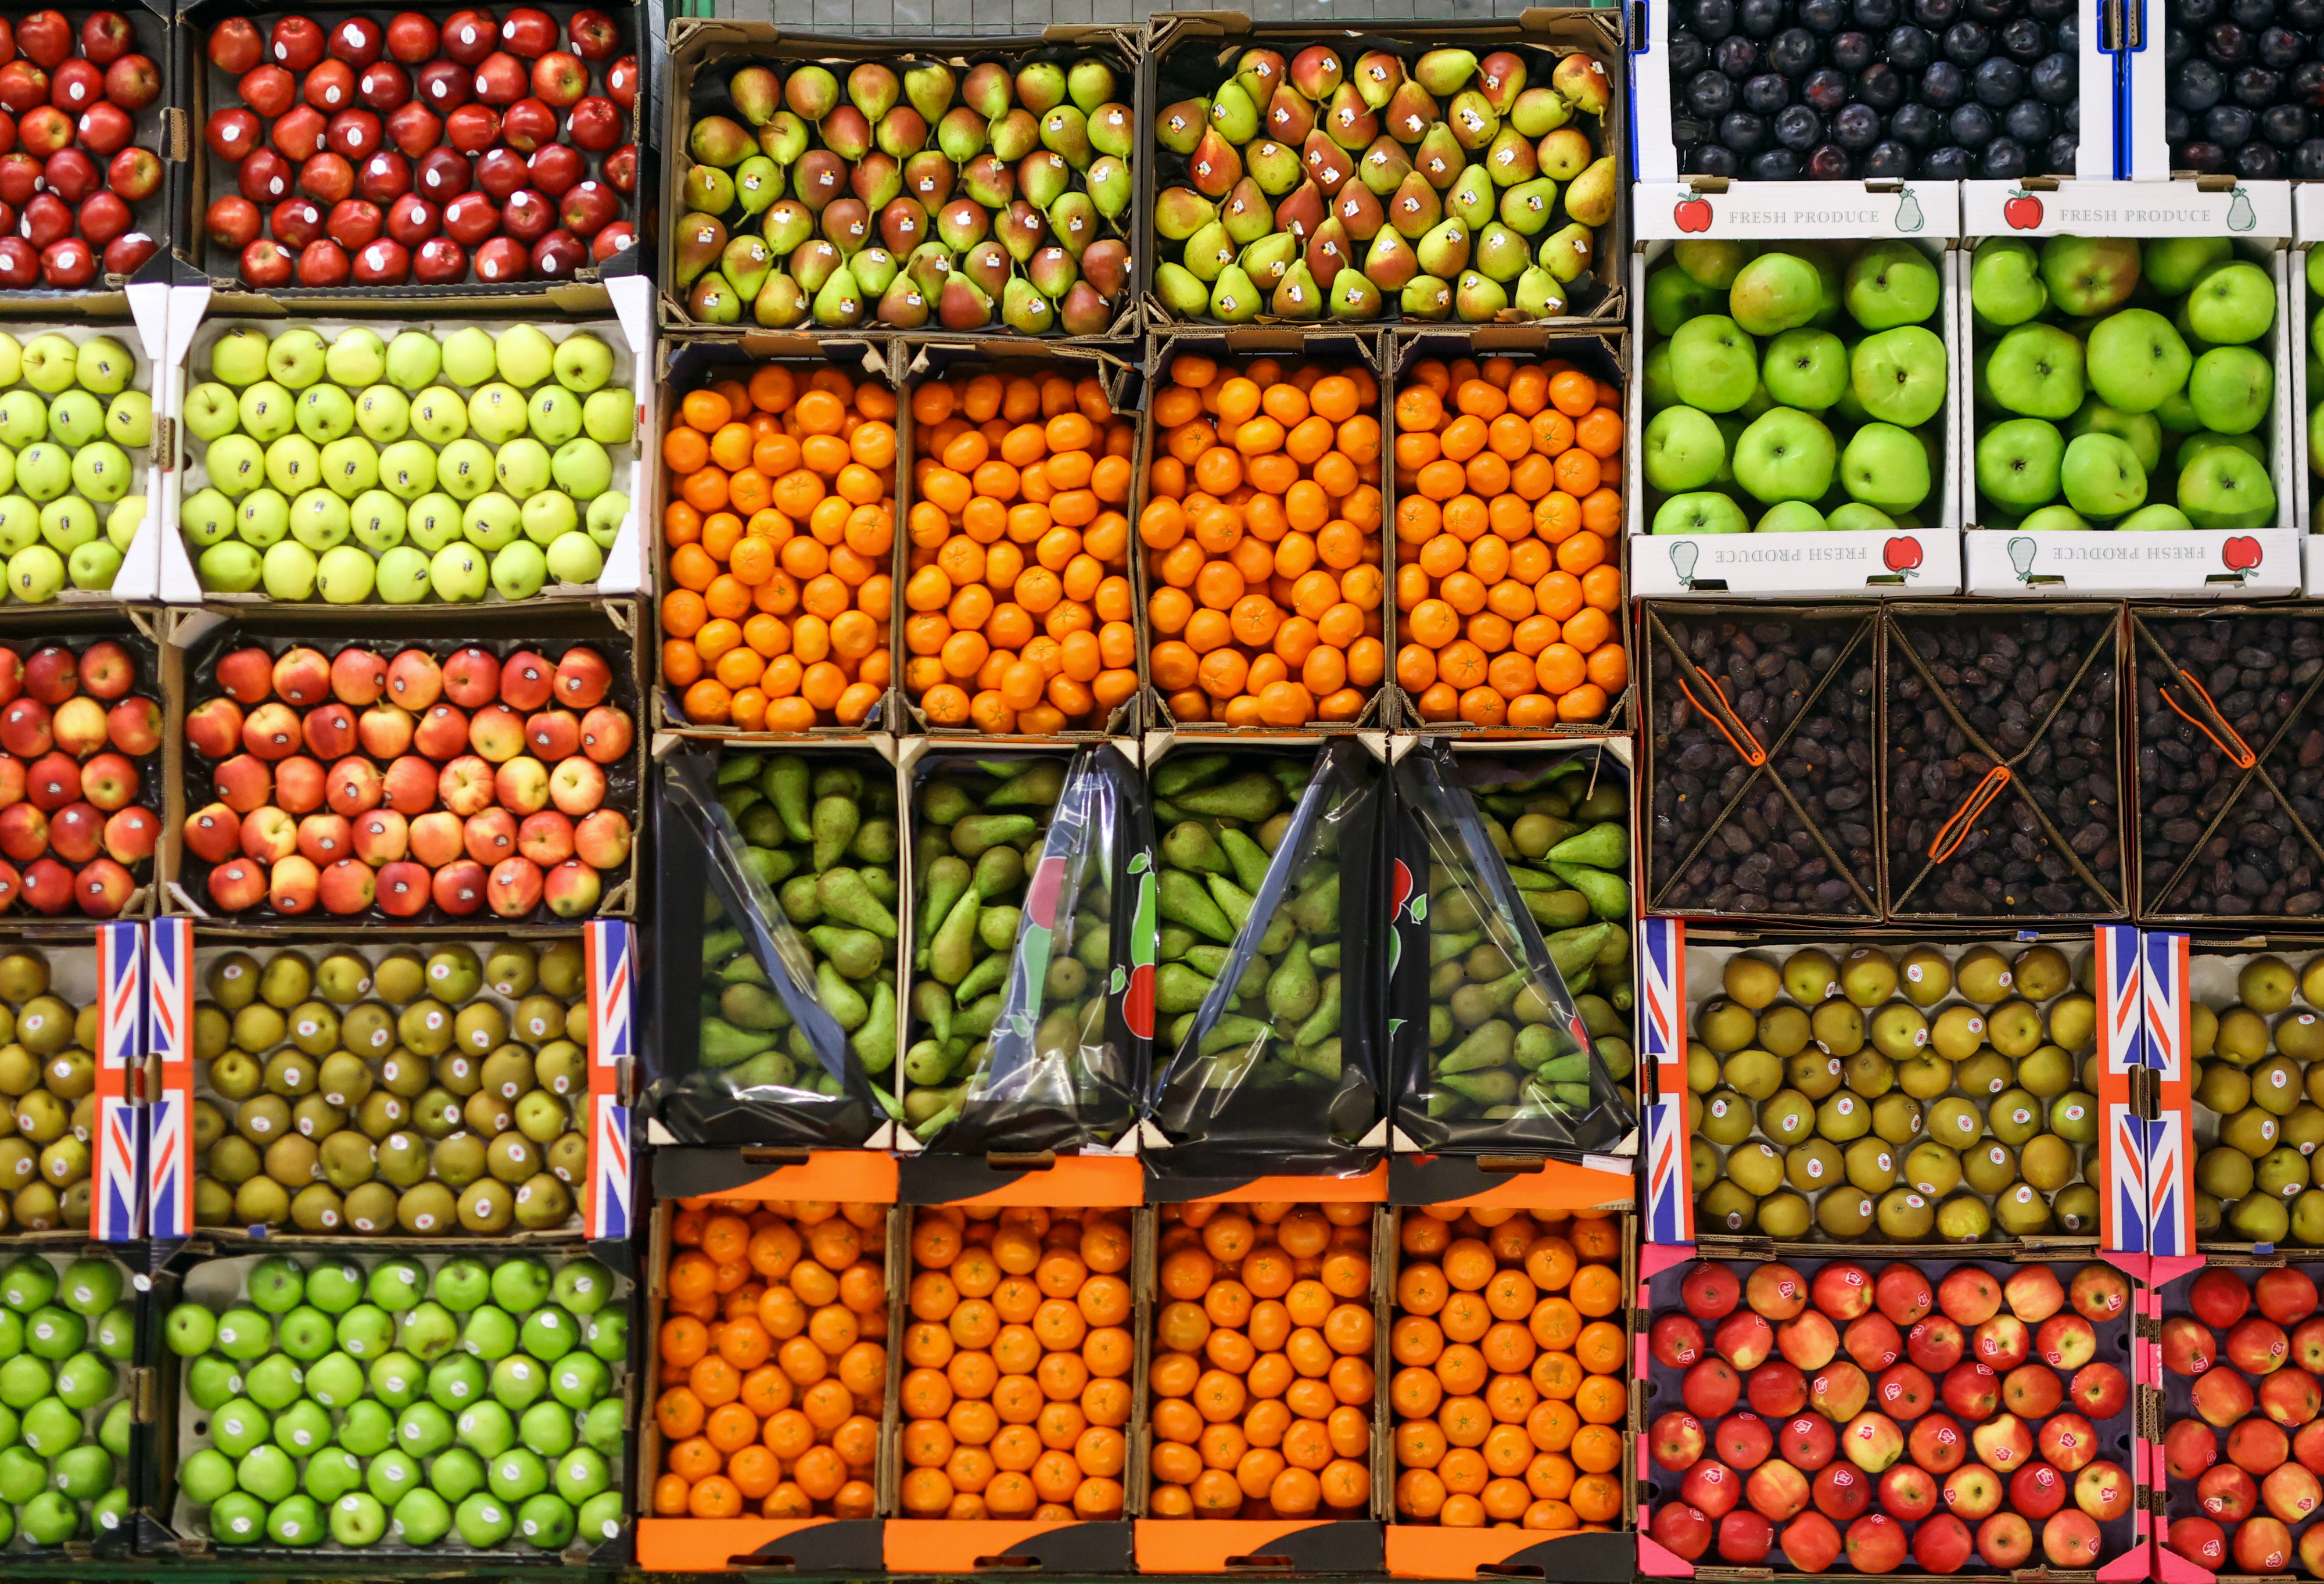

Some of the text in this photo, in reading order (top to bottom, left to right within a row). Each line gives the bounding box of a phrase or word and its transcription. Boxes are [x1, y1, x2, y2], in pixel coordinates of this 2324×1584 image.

[1729, 210, 1879, 223] FRESH PRODUCE
[2060, 209, 2211, 221] FRESH PRODUCE
[1716, 547, 1867, 563] FRESH PRODUCE
[2053, 547, 2205, 560] FRESH PRODUCE
